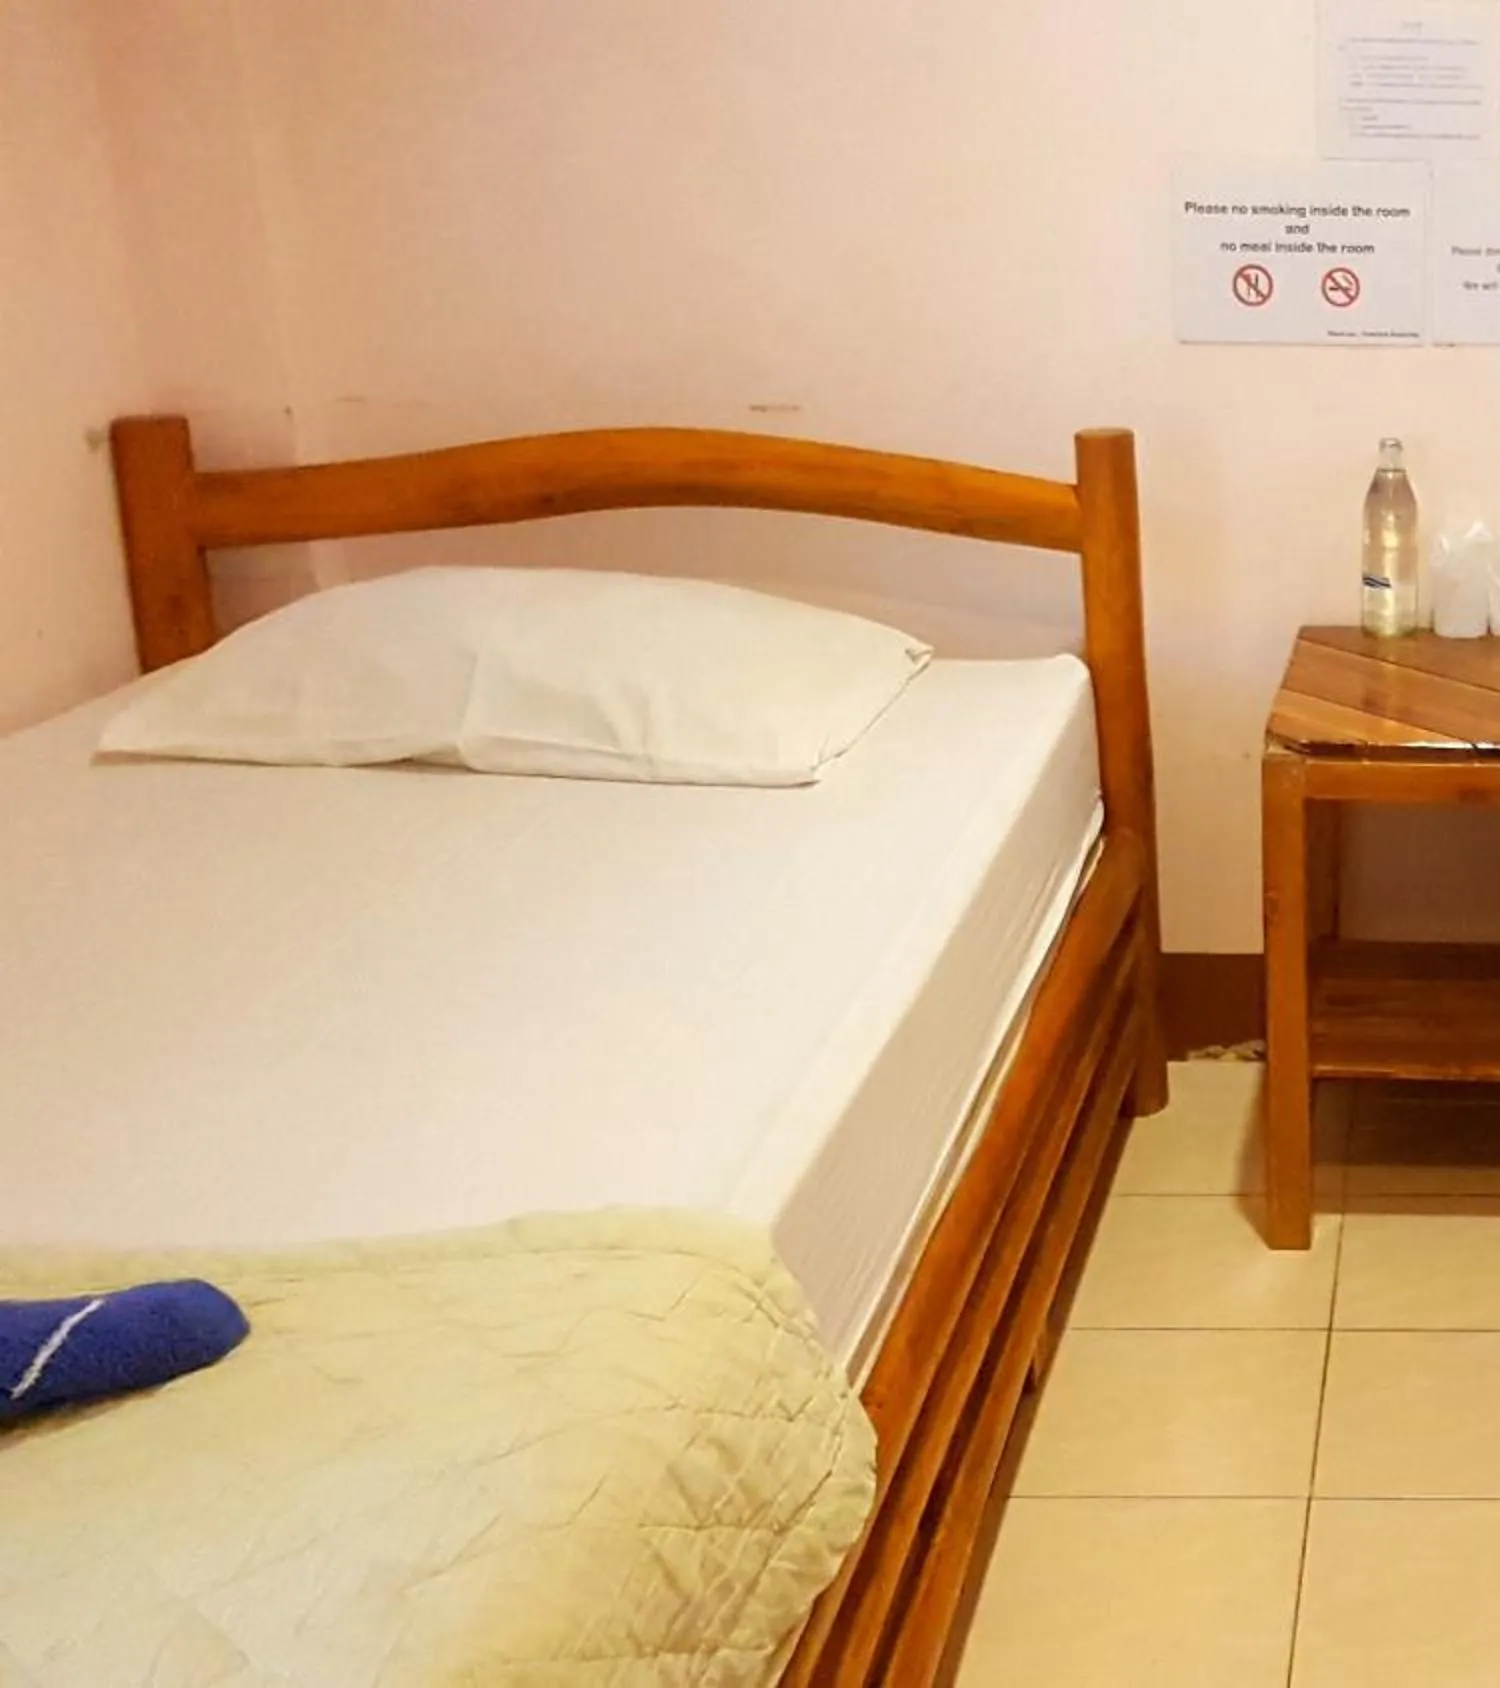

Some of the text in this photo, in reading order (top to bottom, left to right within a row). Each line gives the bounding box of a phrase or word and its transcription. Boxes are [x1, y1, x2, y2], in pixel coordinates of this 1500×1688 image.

[1185, 201, 1411, 218] Please no smoking inside the room
[1285, 224, 1309, 235] and
[1220, 240, 1375, 253] no meal inside the room
